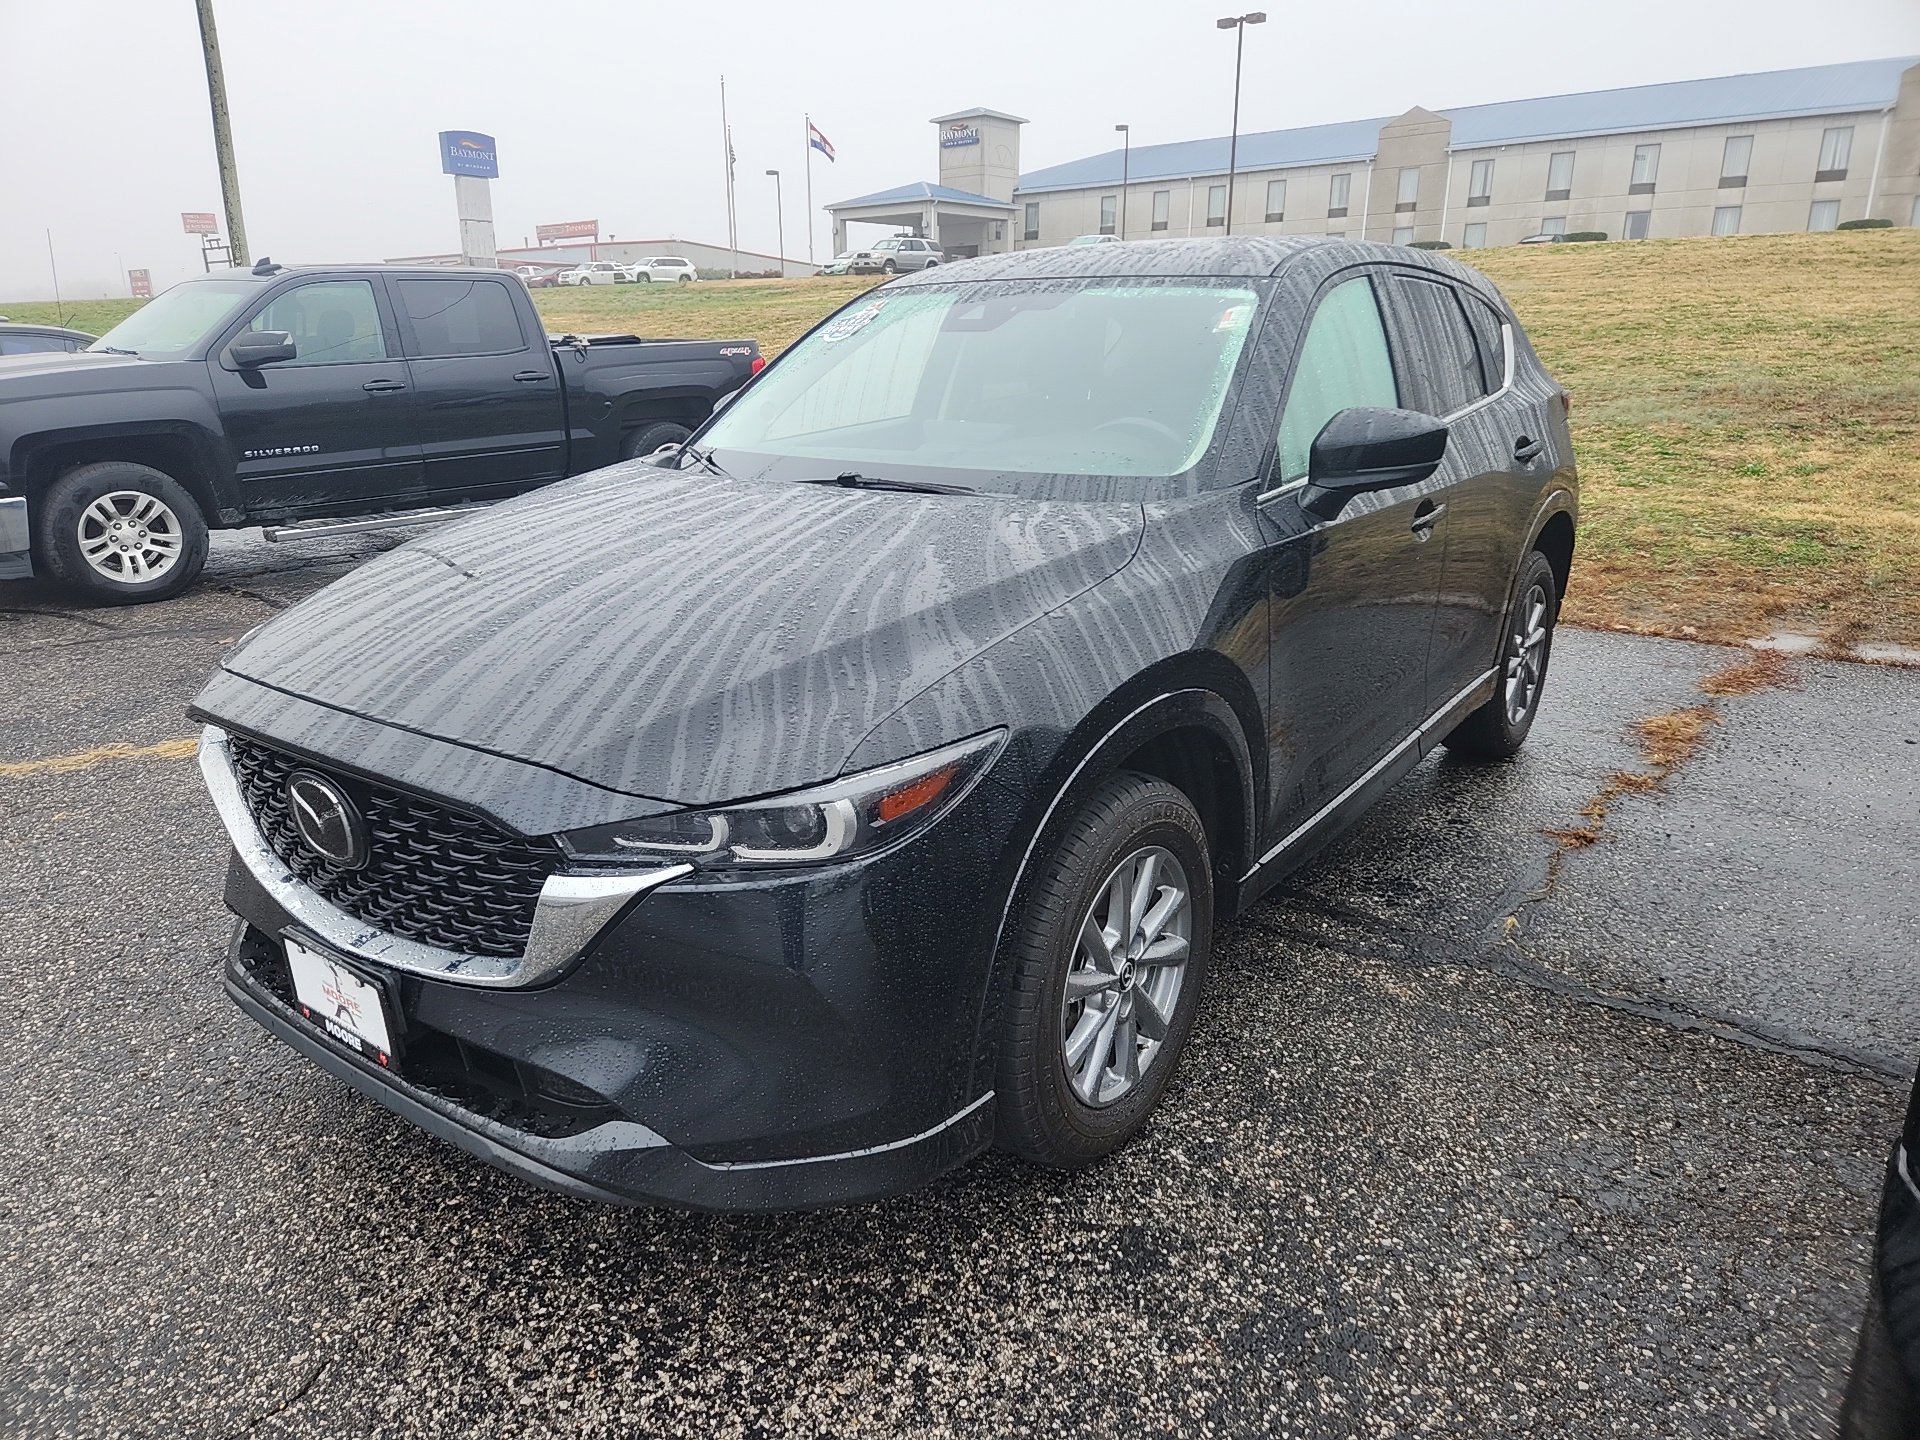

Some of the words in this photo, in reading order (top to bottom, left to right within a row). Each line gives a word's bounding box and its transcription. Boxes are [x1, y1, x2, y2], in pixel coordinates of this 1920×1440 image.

[941, 127, 977, 141] BAYMONT
[450, 146, 494, 161] BAYMONT
[244, 445, 319, 458] SILVERADO
[322, 983, 361, 1011] MOORE
[324, 1018, 363, 1052] MOORE
